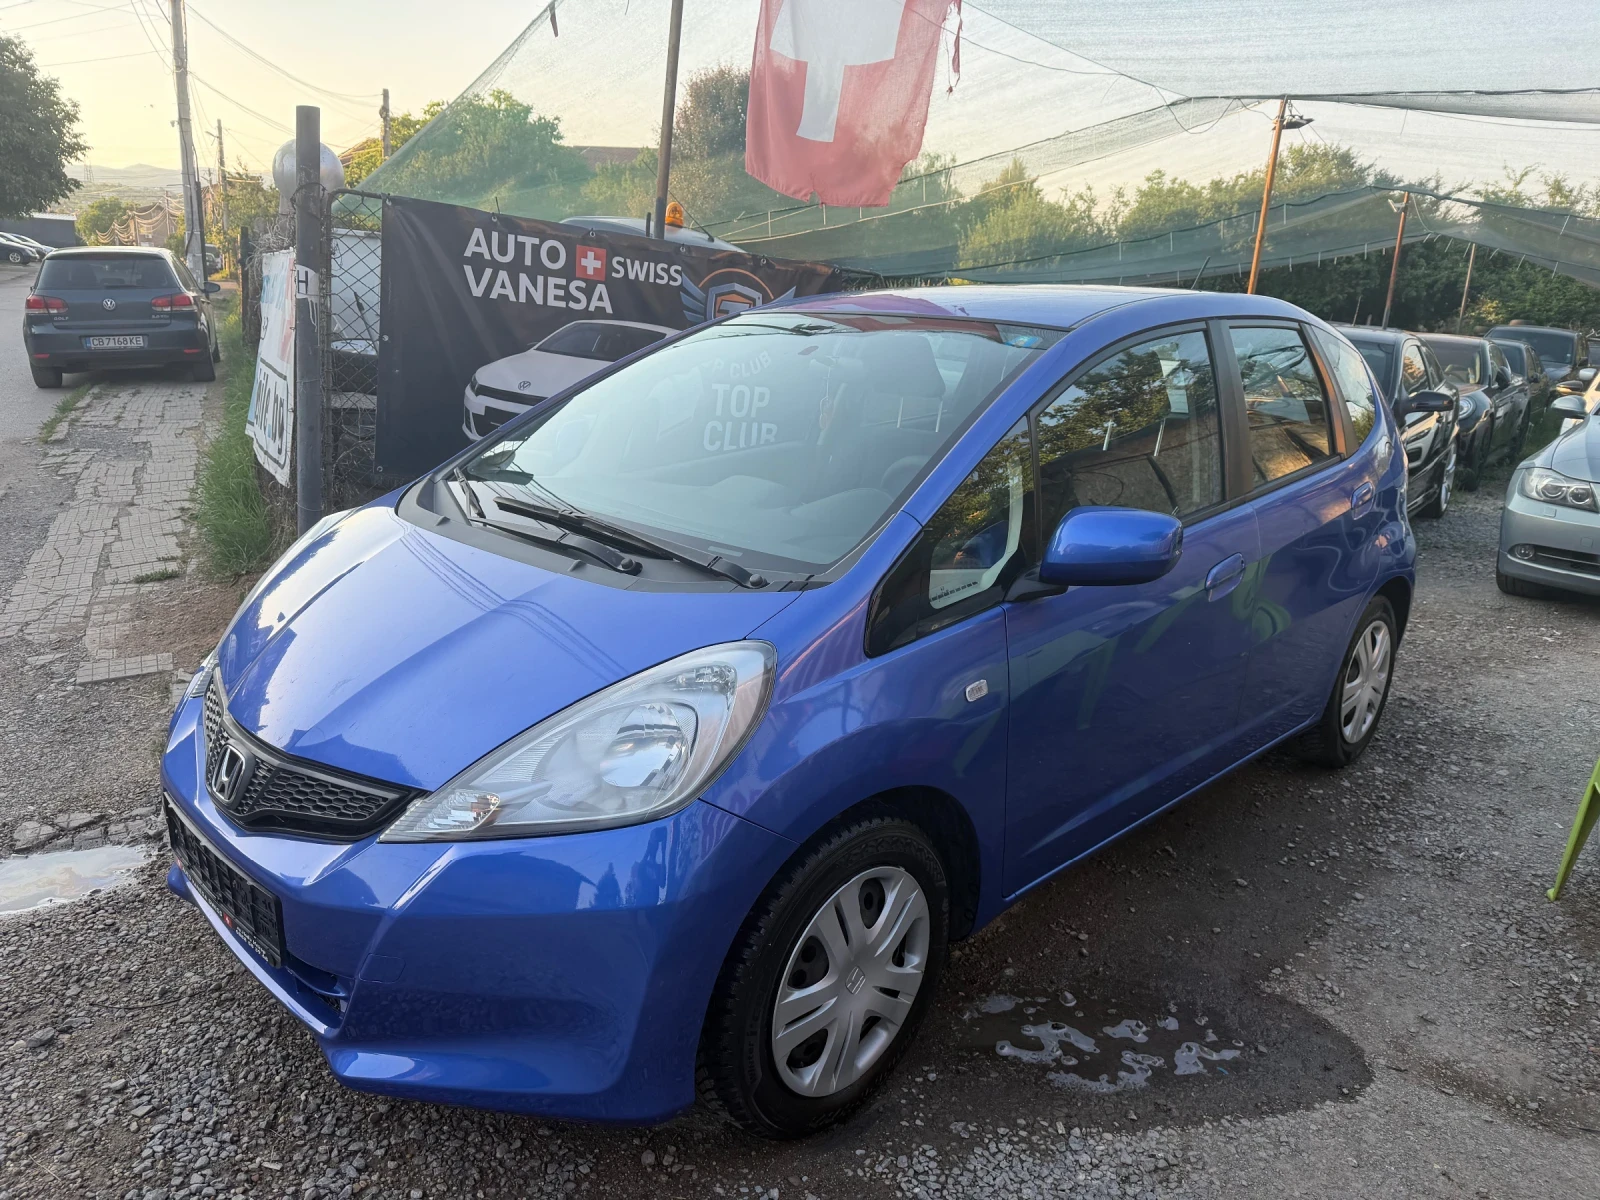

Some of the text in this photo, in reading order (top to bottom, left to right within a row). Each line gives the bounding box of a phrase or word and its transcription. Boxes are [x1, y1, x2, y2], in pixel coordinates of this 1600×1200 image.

[463, 227, 567, 270] AUTO
[463, 264, 613, 314] VANESA
[611, 256, 683, 287] SWISS
[729, 350, 771, 379] CLUB
[711, 383, 771, 418] TOP
